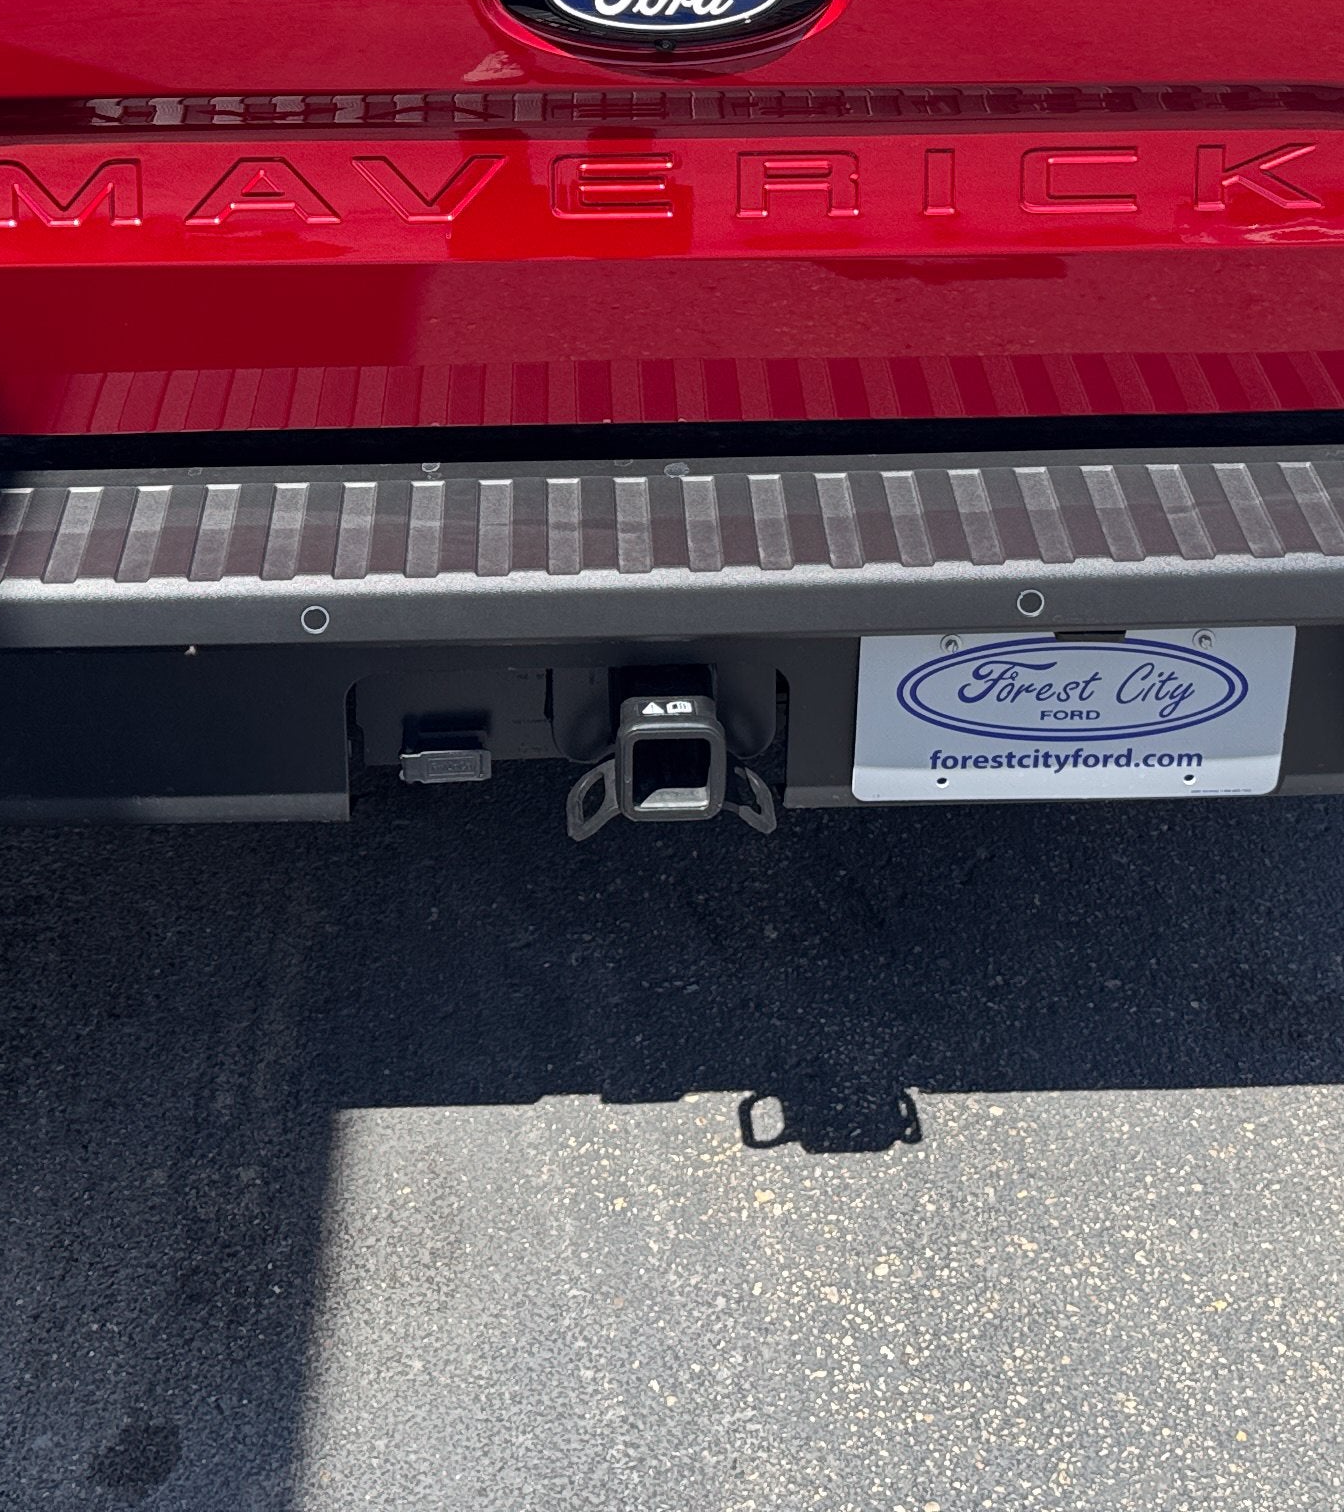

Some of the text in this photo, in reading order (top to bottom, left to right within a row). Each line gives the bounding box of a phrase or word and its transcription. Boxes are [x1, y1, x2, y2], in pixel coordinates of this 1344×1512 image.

[958, 660, 1195, 719] Forest City
[1038, 709, 1102, 722] FORD
[929, 748, 1203, 774] forestcityford.com
